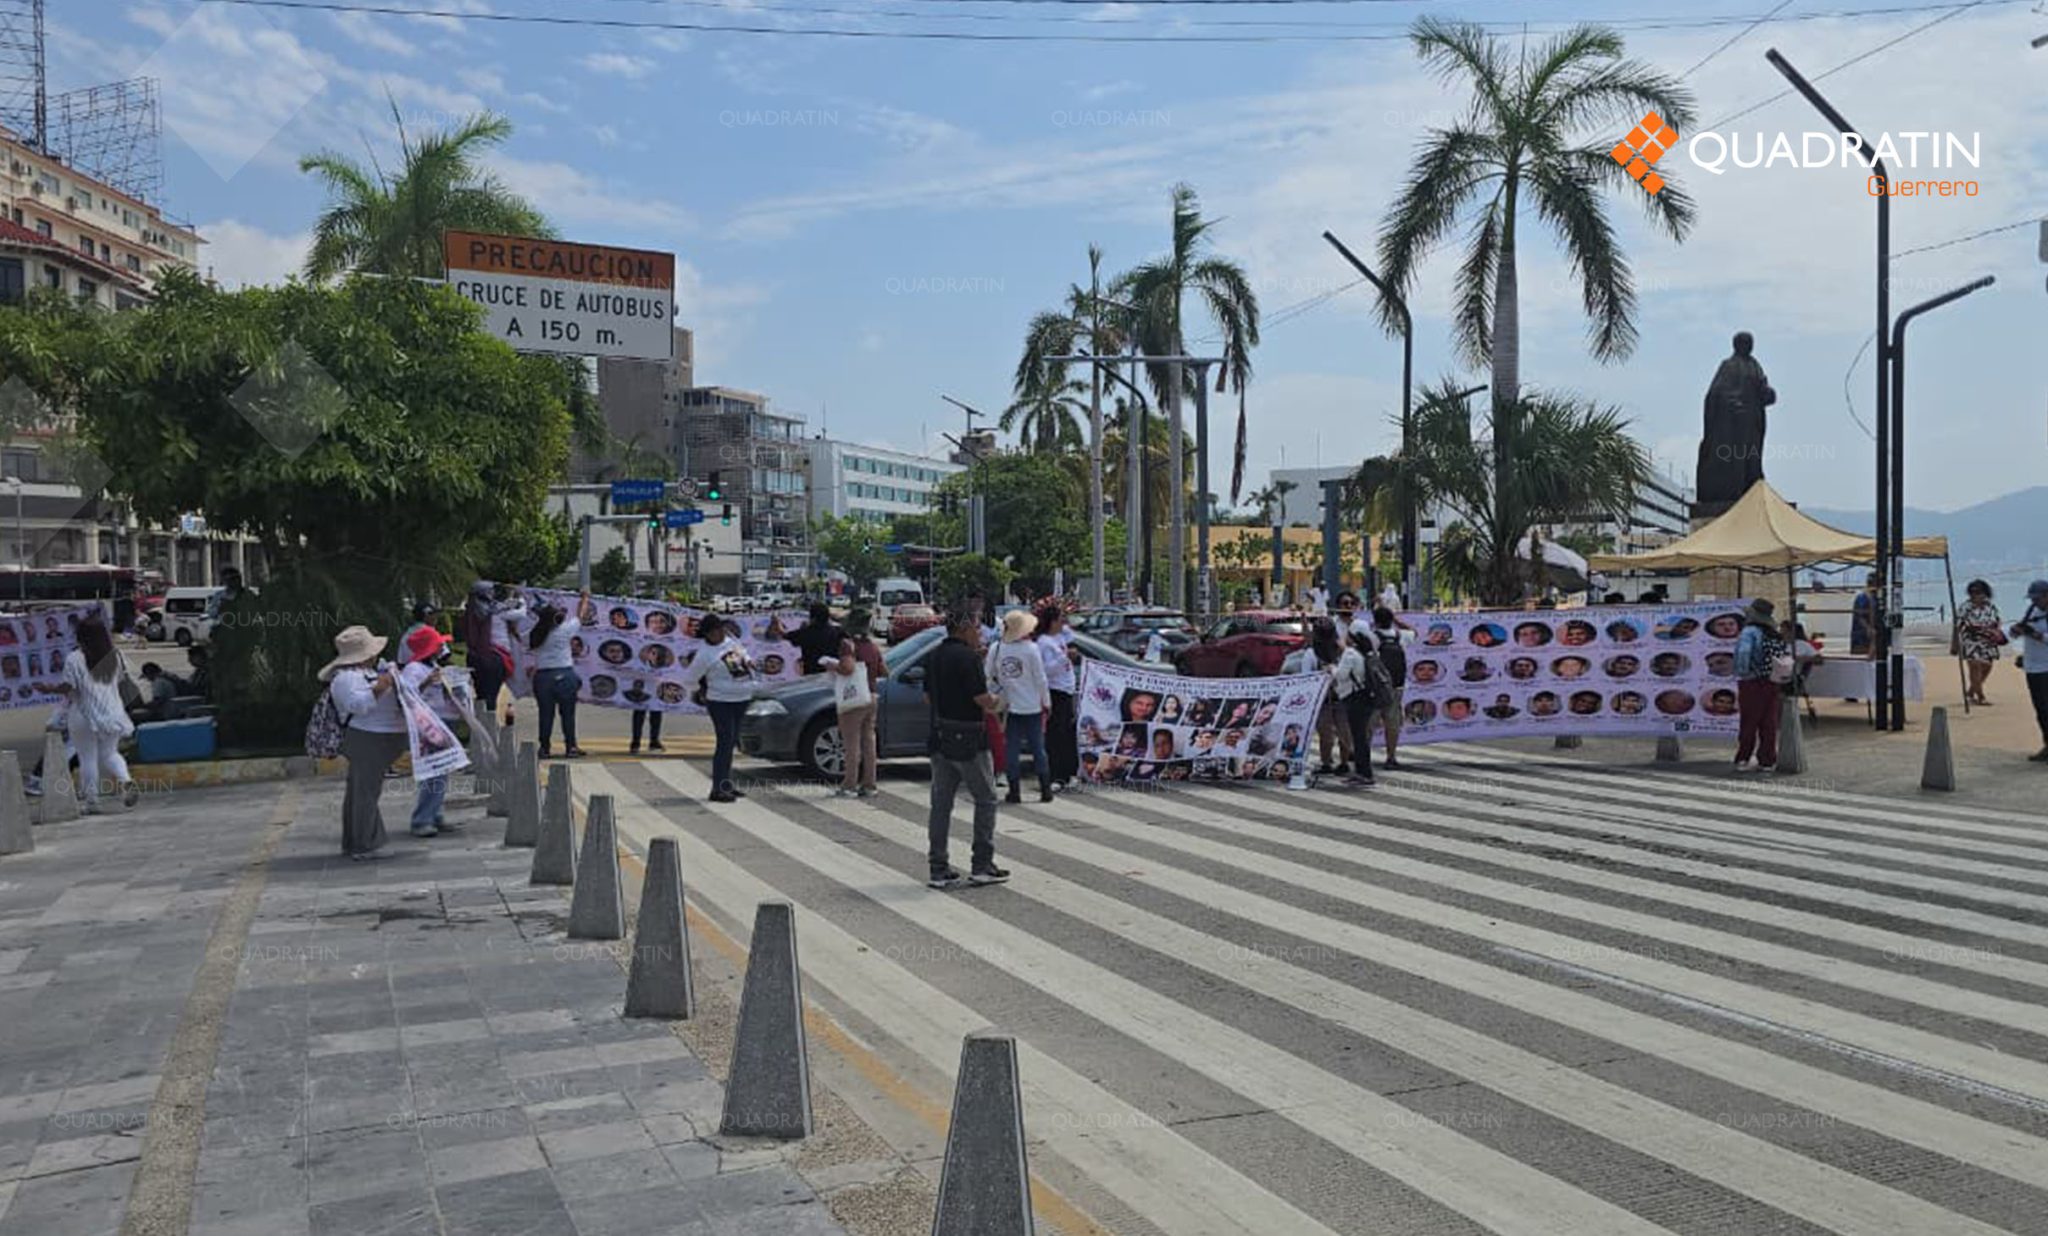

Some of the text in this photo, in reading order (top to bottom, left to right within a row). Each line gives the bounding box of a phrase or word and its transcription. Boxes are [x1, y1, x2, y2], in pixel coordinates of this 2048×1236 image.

[469, 240, 654, 278] PRECAUCION
[457, 281, 665, 319] CRUCE DE AUTOBUS
[506, 317, 623, 345] A 150 m.
